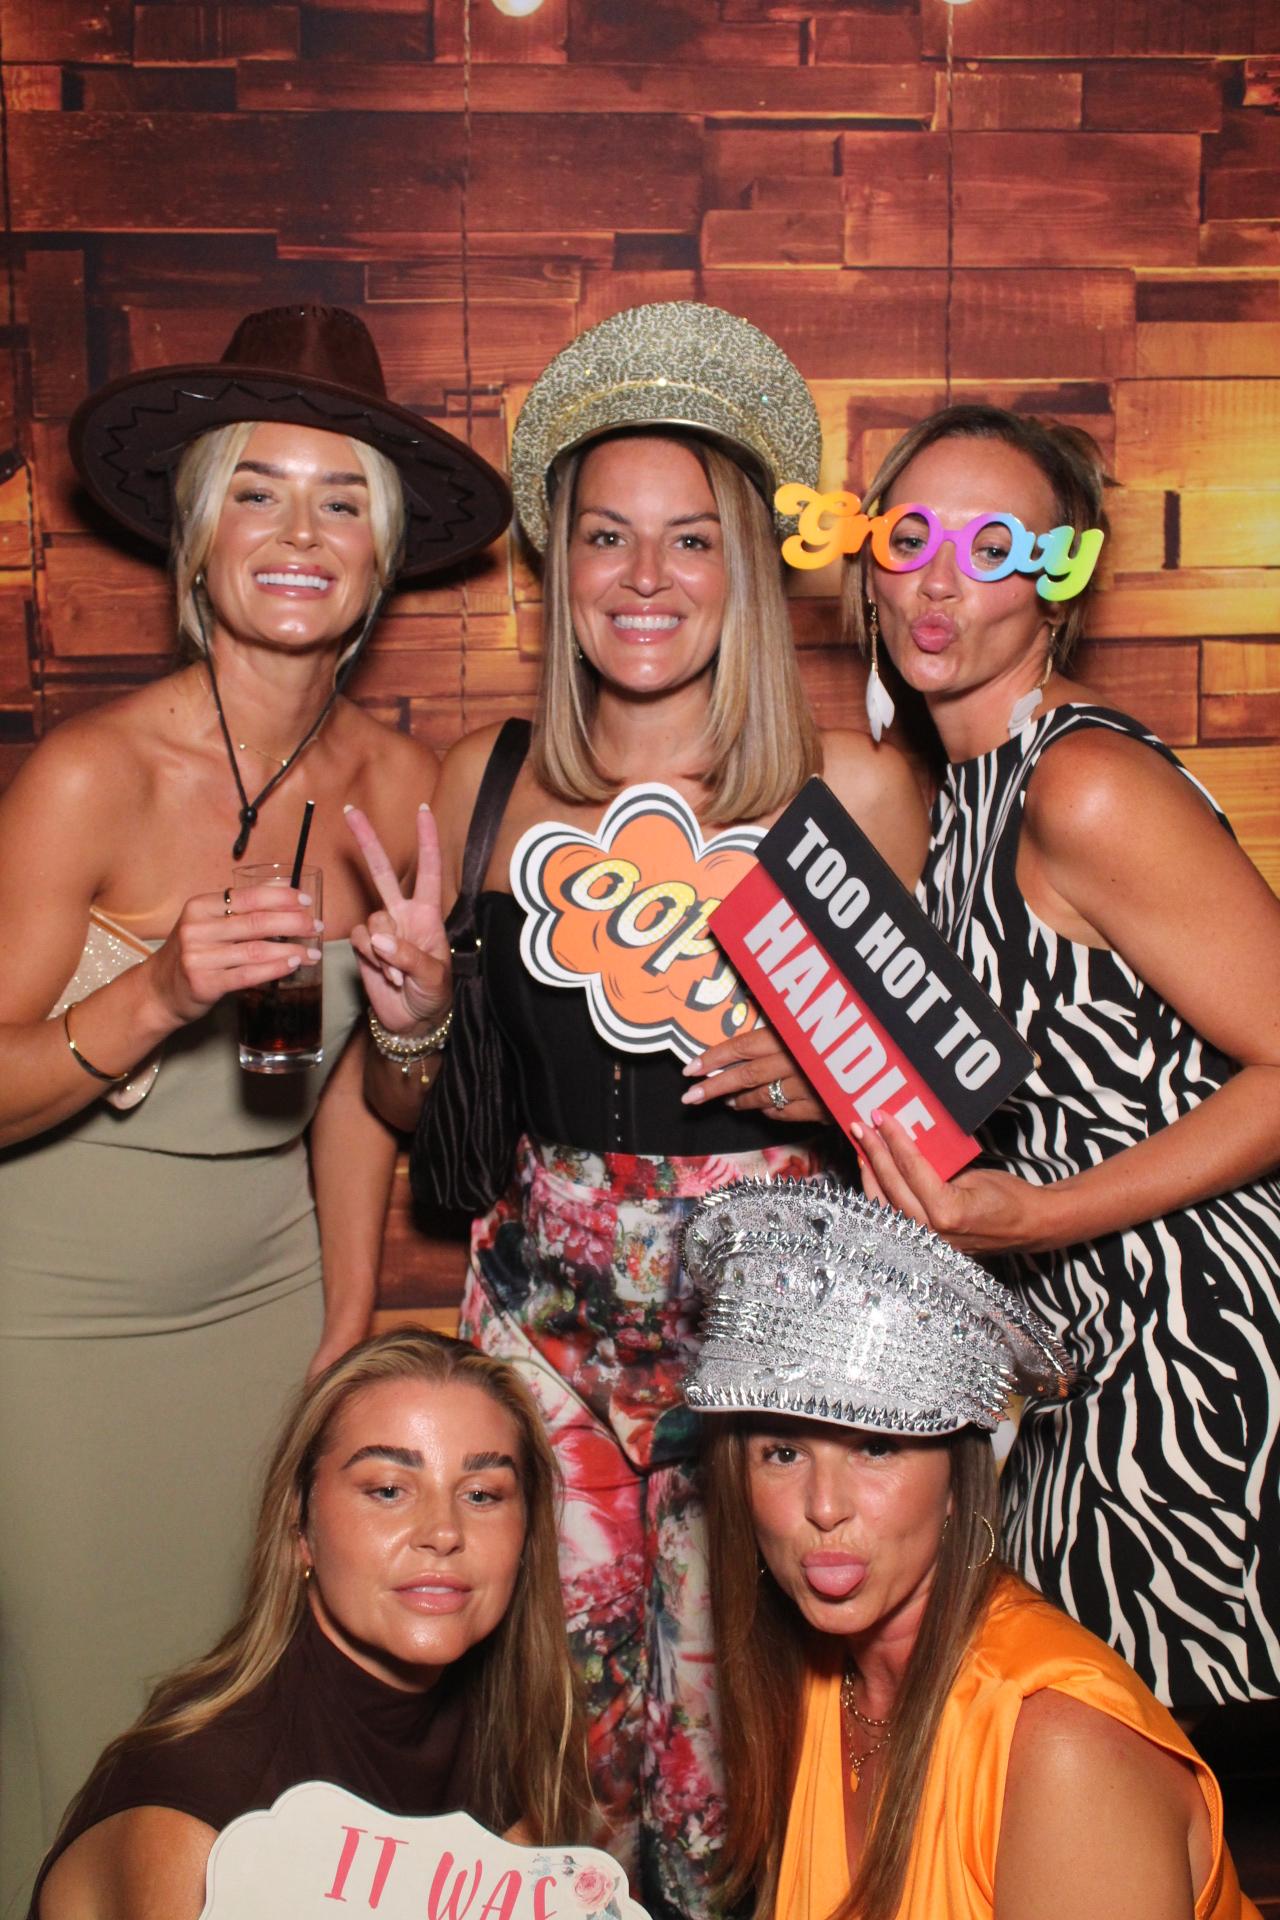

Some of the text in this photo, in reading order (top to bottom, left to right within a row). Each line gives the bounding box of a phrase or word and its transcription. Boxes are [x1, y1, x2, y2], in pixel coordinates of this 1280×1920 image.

[786, 817, 1001, 1091] TOO HOT TO
[324, 1825, 410, 1910] IT
